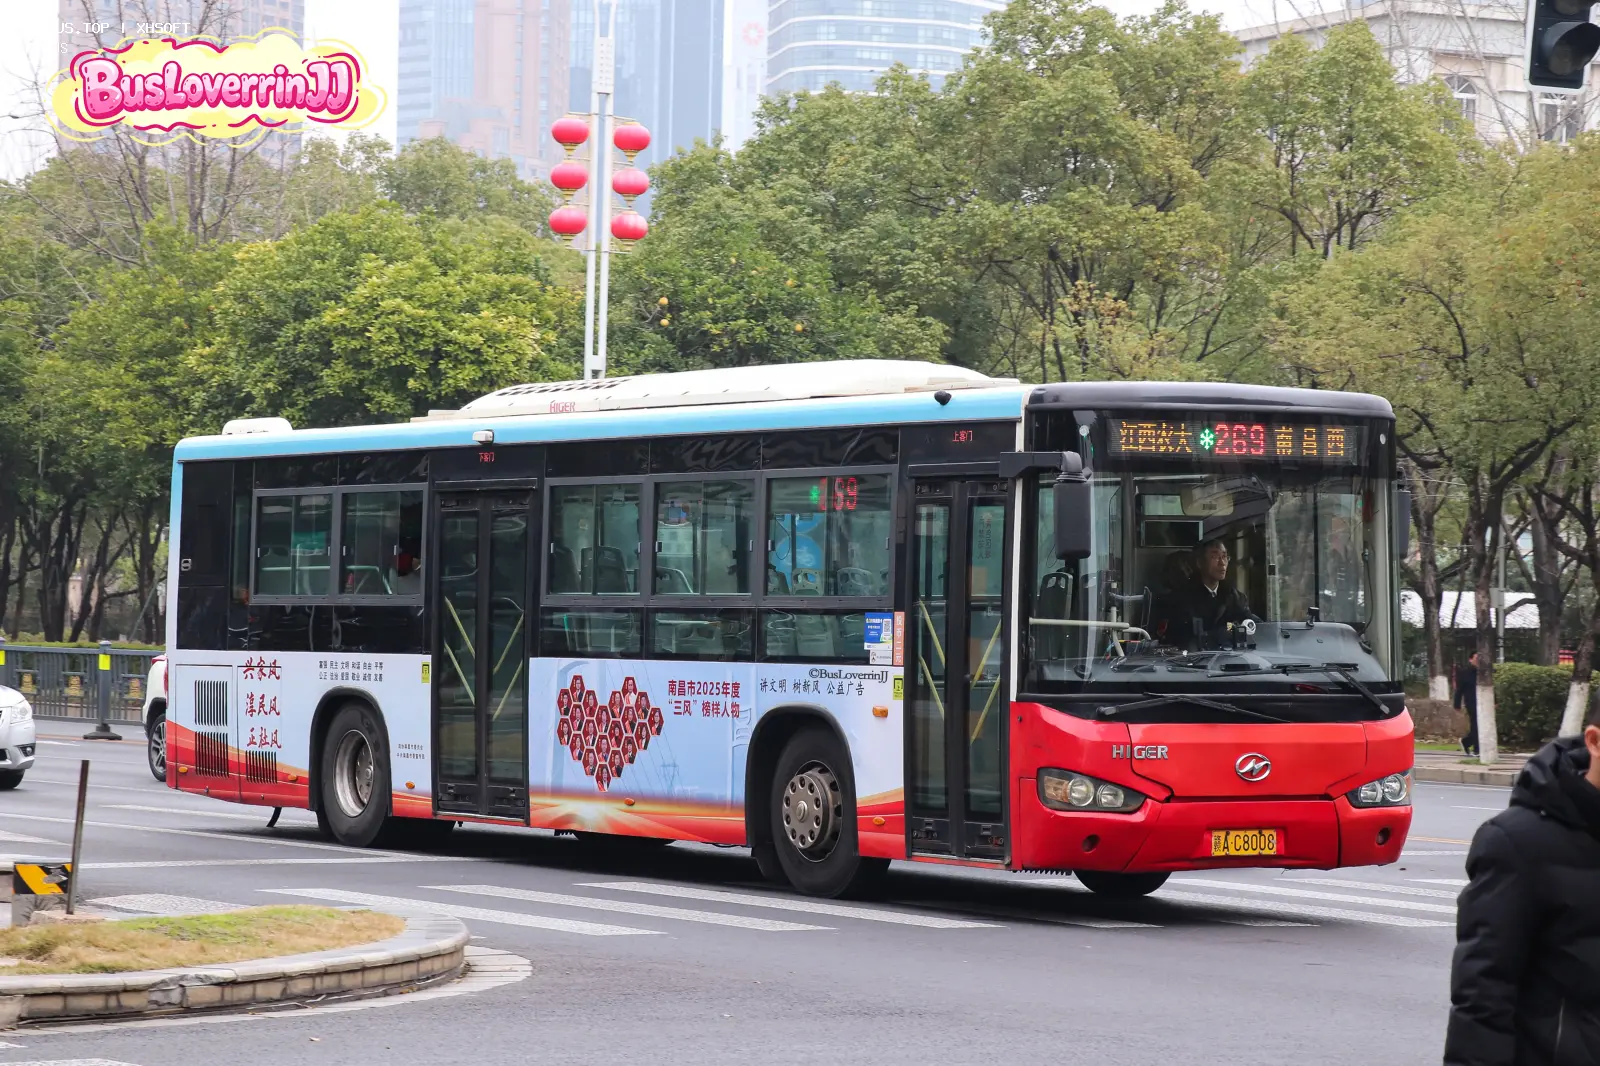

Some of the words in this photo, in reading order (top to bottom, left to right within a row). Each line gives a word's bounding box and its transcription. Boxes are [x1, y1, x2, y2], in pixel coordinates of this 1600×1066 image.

[1214, 424, 1265, 455] 269
[1273, 425, 1345, 456] 南昌西
[242, 656, 281, 681] 兴家风
[668, 679, 741, 699] 南昌市2025年度
[759, 677, 788, 694] 讲文明
[792, 678, 821, 695] 树新风
[826, 680, 865, 697] 公益广告
[246, 726, 282, 750] 正社风
[1111, 744, 1169, 760] HIGER
